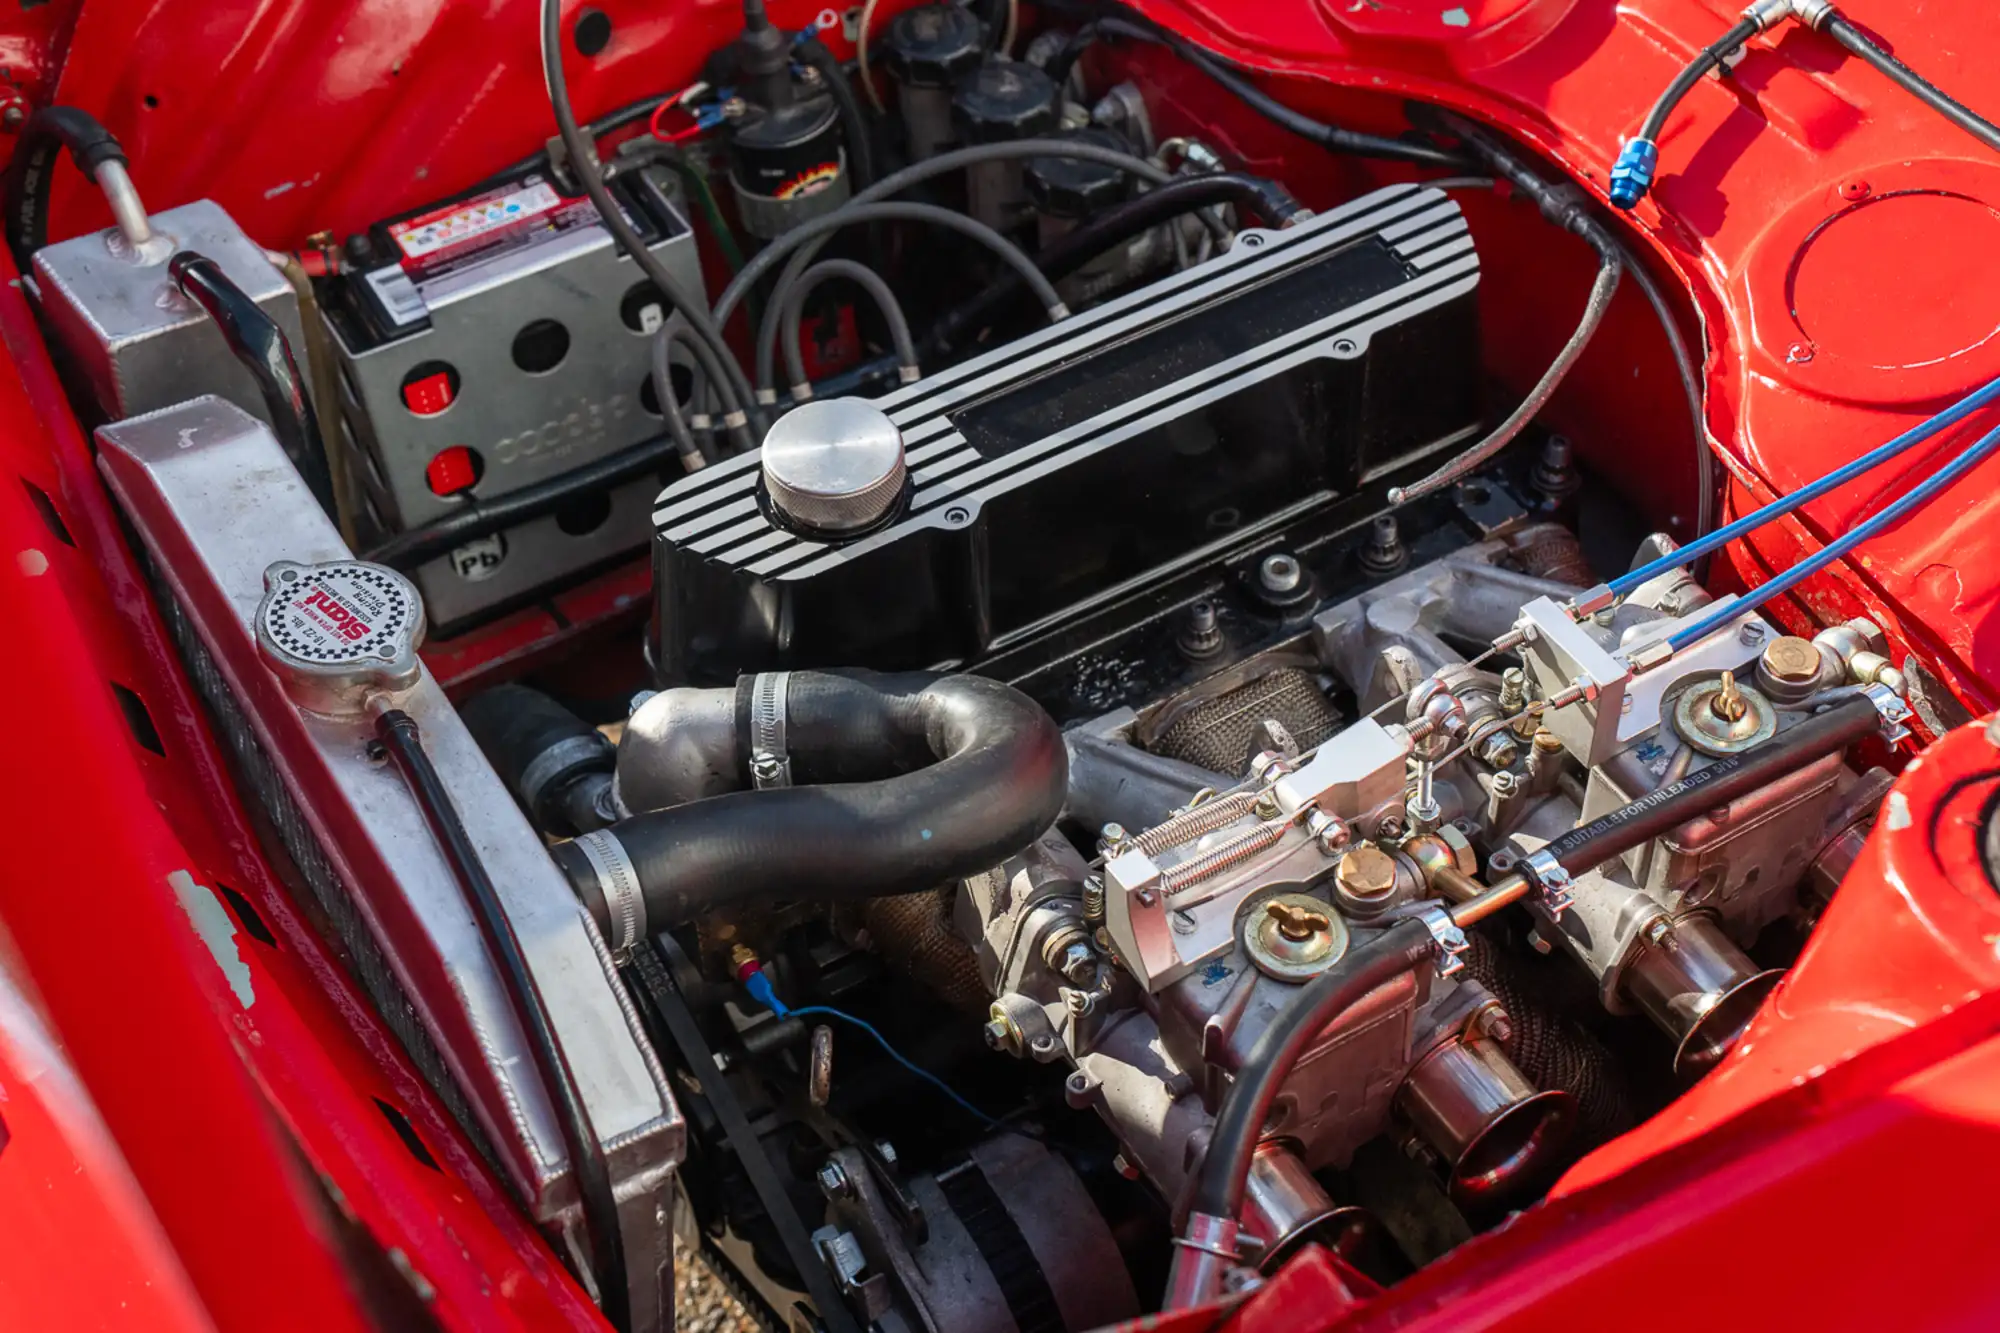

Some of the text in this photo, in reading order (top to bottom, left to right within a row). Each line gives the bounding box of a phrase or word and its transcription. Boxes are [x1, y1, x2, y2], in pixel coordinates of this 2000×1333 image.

[461, 552, 499, 576] Pb
[318, 581, 339, 598] MEXICO
[350, 580, 386, 609] Division
[303, 590, 372, 640] Stant
[342, 600, 374, 624] ASSEMBLED
[352, 590, 383, 617] Racing
[302, 627, 327, 646] 18-22
[330, 629, 343, 639] NOT
[1562, 813, 1622, 849] SUITABLE
[1620, 800, 1650, 820] FOR
[1646, 771, 1711, 807] UNLEADED
